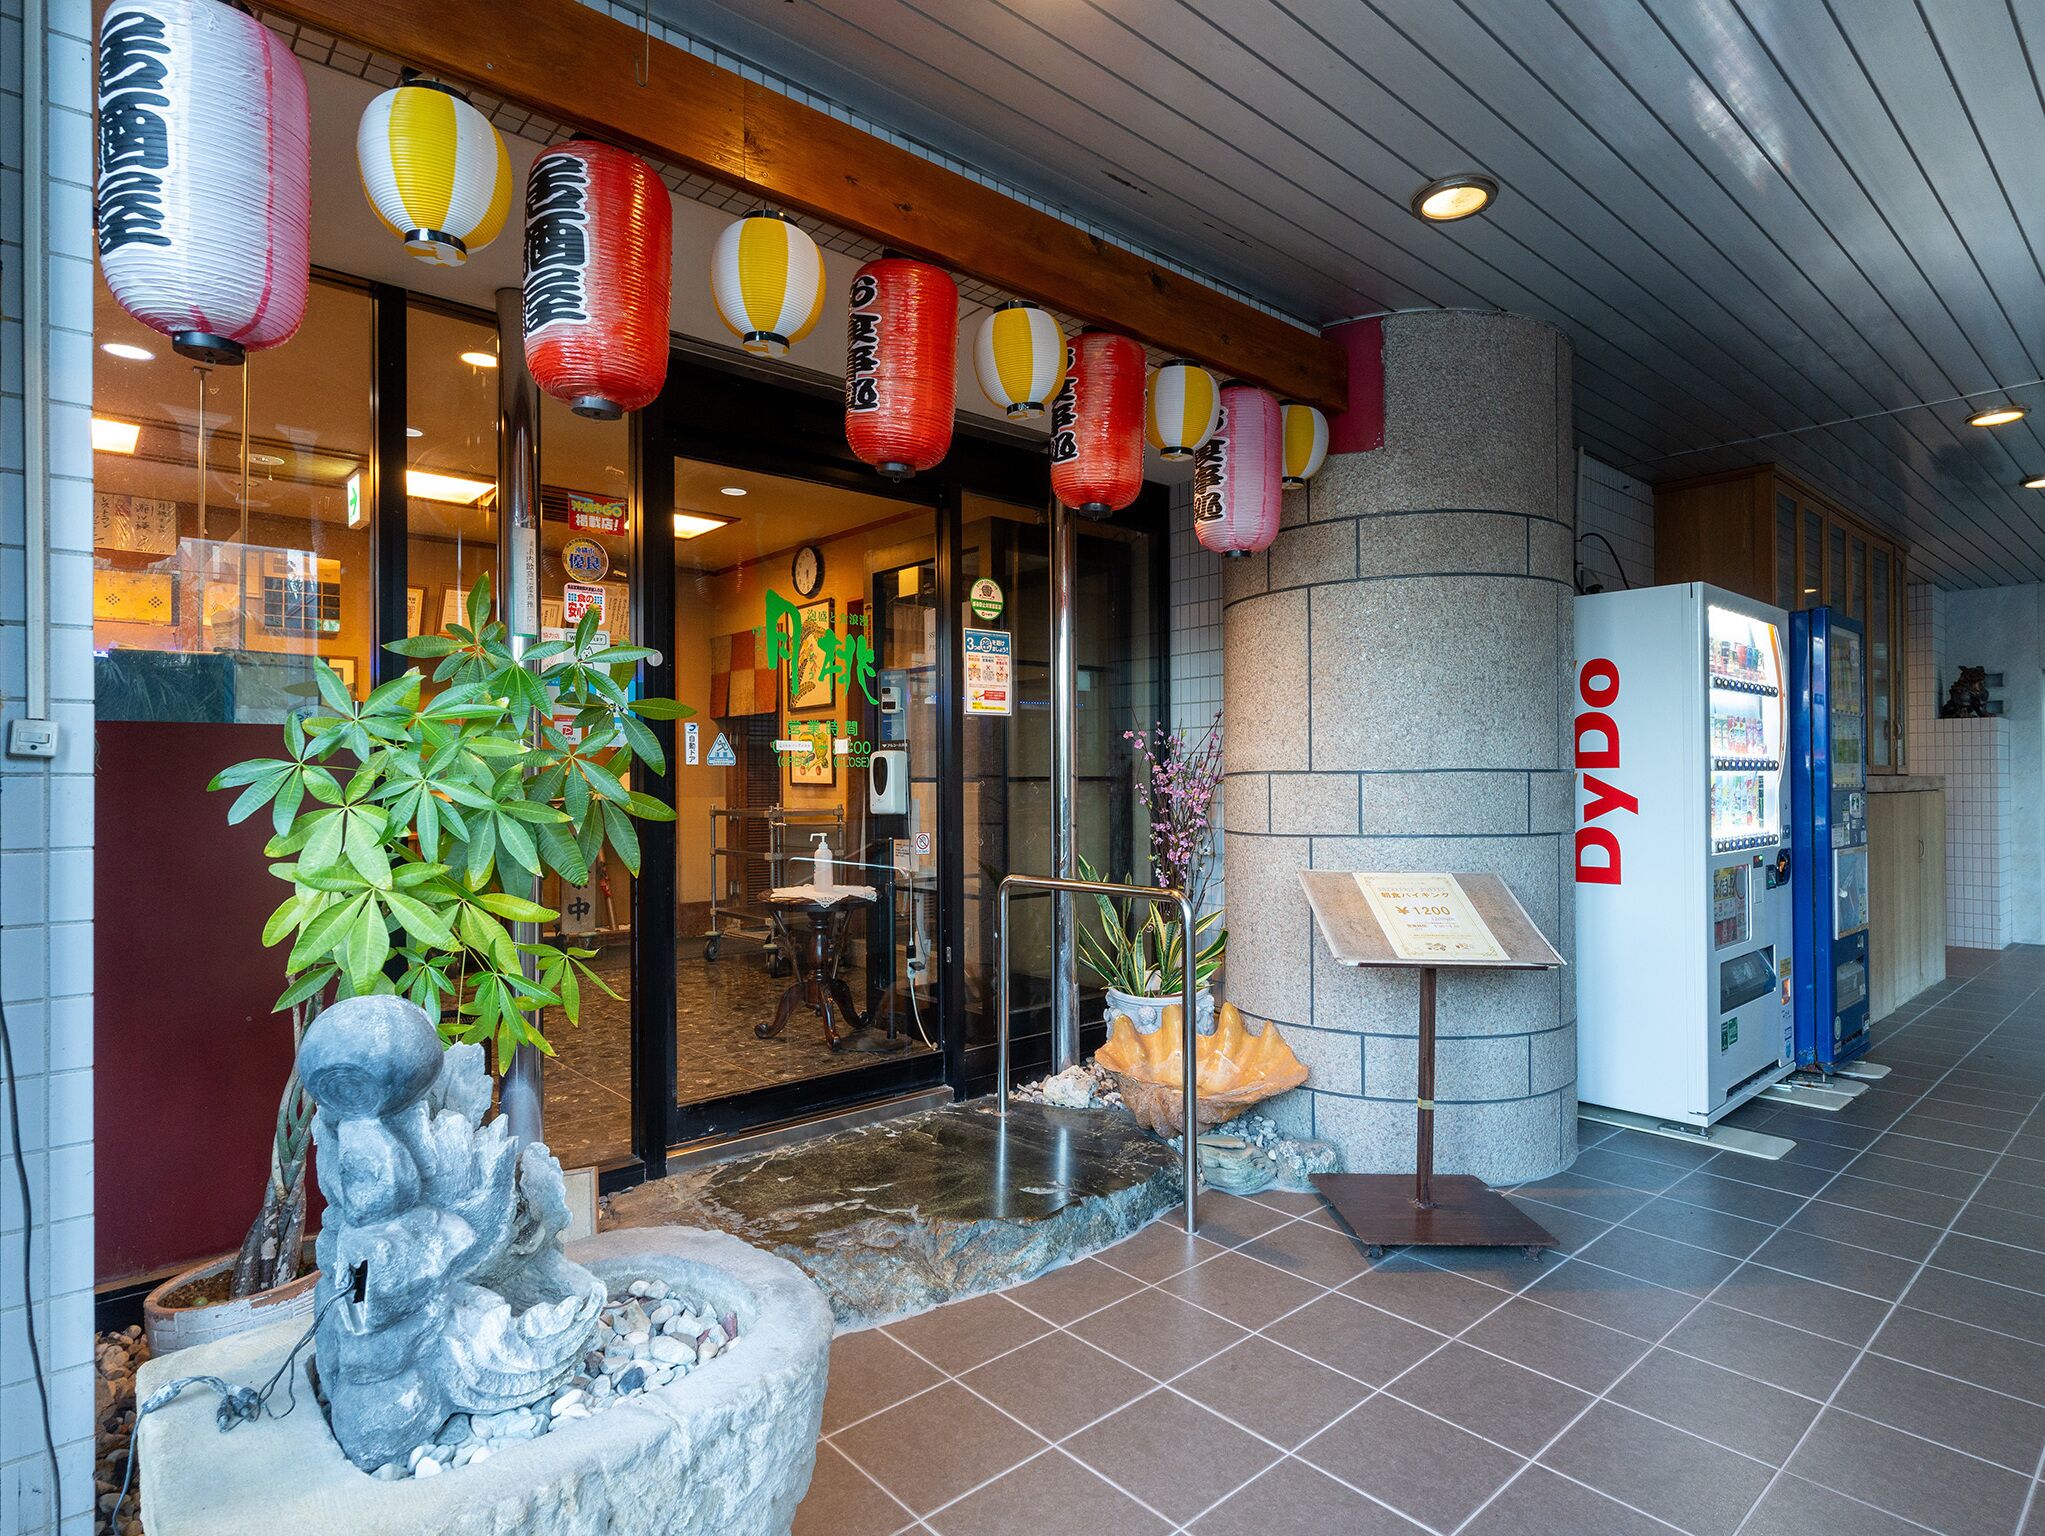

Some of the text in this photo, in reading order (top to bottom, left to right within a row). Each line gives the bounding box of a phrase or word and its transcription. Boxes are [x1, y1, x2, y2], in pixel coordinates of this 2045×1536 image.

[577, 593, 595, 604] 食の
[787, 720, 859, 736] 営業時間
[1574, 657, 1639, 885] DyDo
